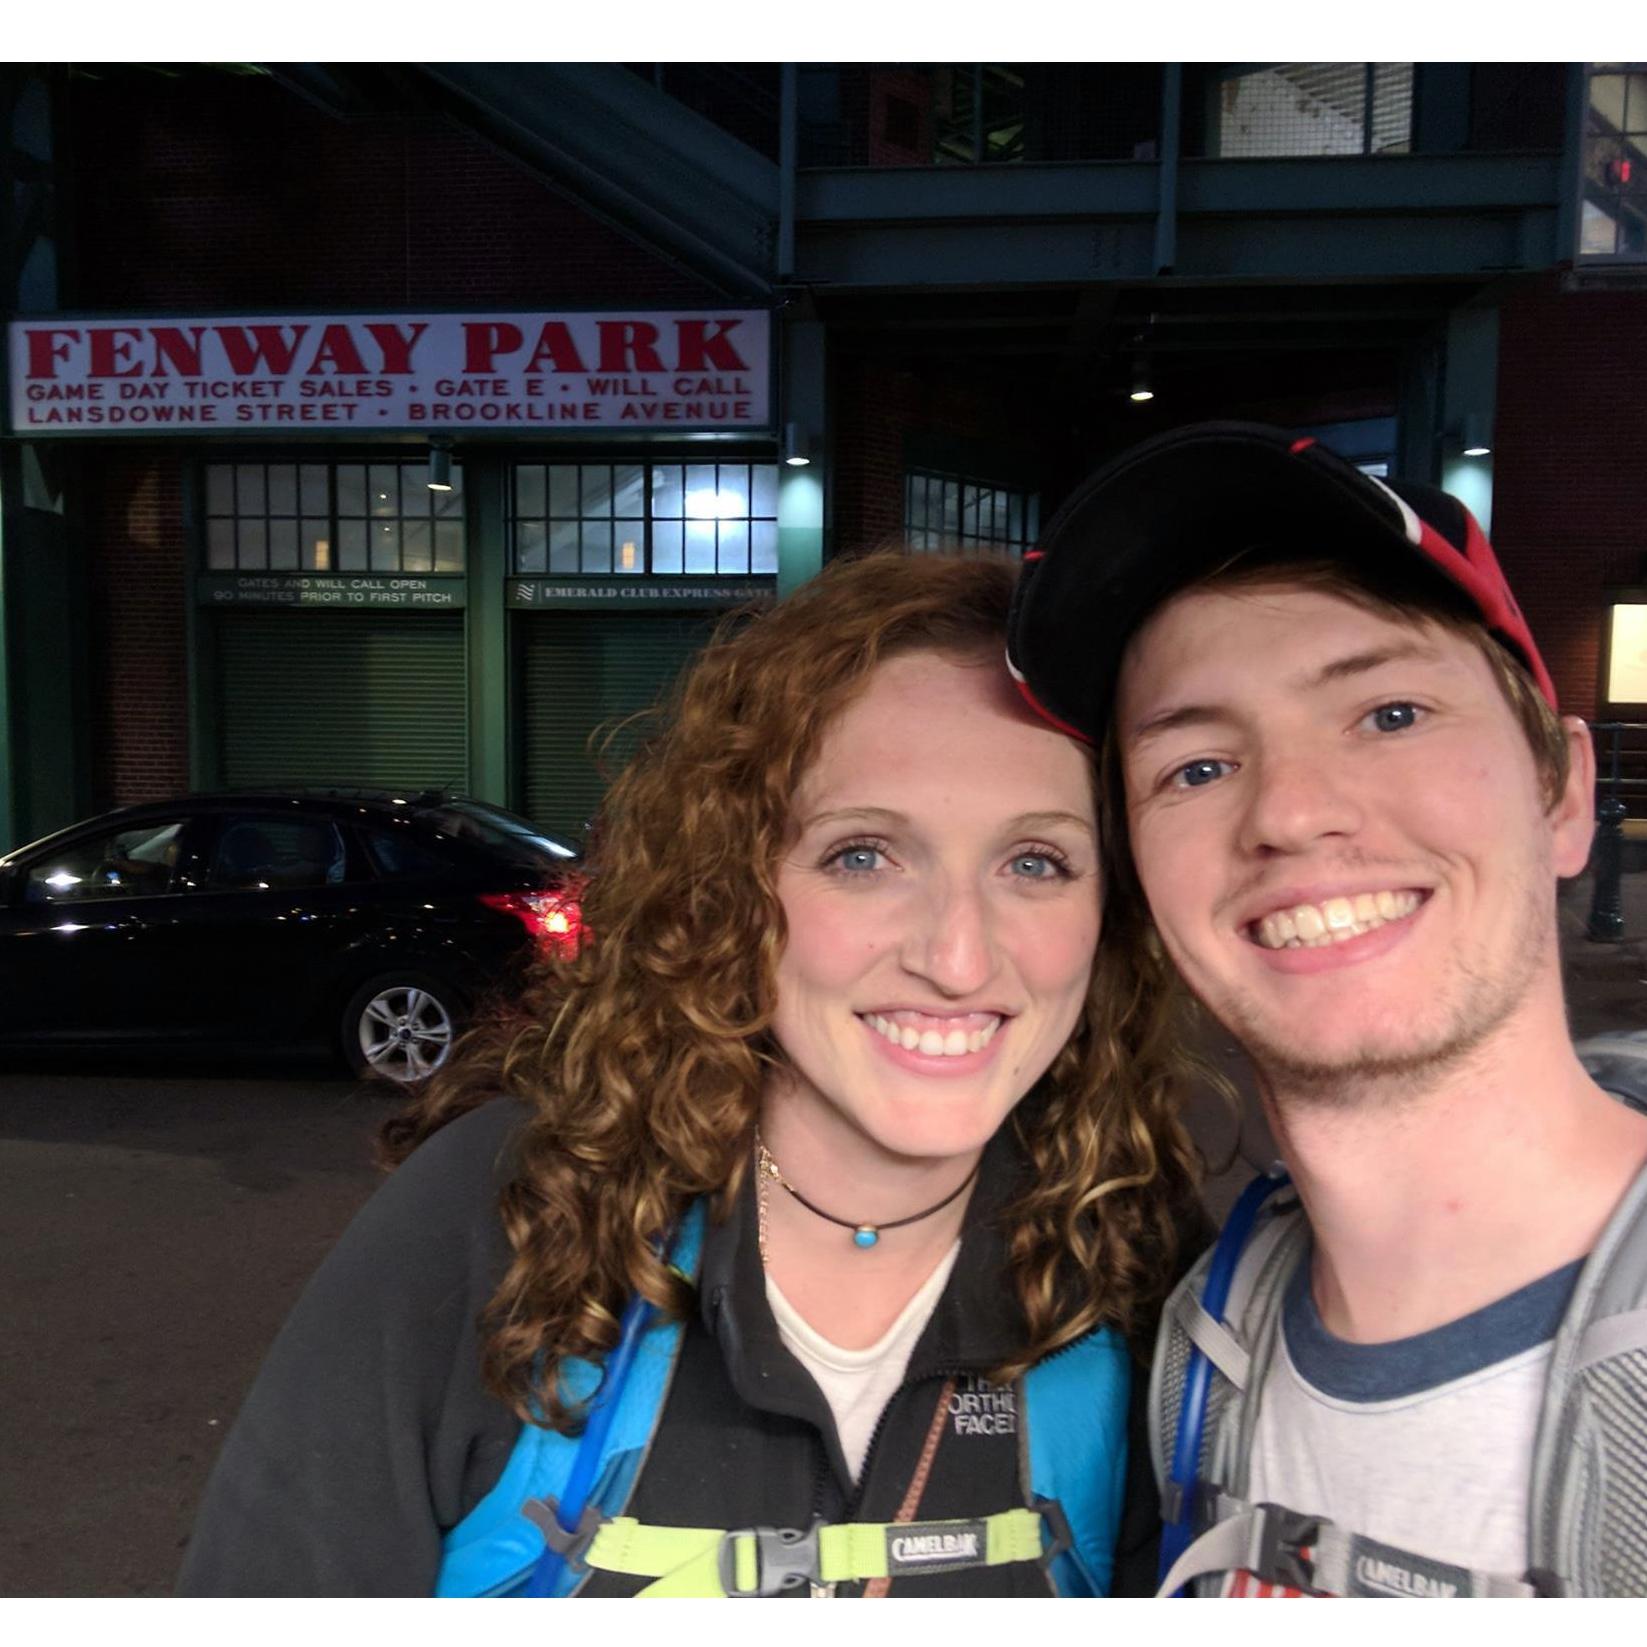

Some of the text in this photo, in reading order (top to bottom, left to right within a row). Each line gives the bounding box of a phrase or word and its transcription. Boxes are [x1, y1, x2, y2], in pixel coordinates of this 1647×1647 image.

[25, 318, 751, 379] FENWAY PARK
[26, 376, 752, 401] GAME DAY TICKET SALES GATE E WILL CALL
[28, 401, 752, 424] LANSDOWNE STREET BROOKLINE AVENUE
[238, 578, 427, 590] GATES AND WILL CALL OPEN
[545, 587, 617, 598] EMERALD
[620, 587, 660, 598] CLUB
[661, 587, 731, 598] EXPRESS
[214, 590, 452, 603] 90 MINUTES PRIOR TO FIRST PITCH
[947, 1393, 1008, 1414] ORTH
[891, 1532, 978, 1562] CAMELBAK
